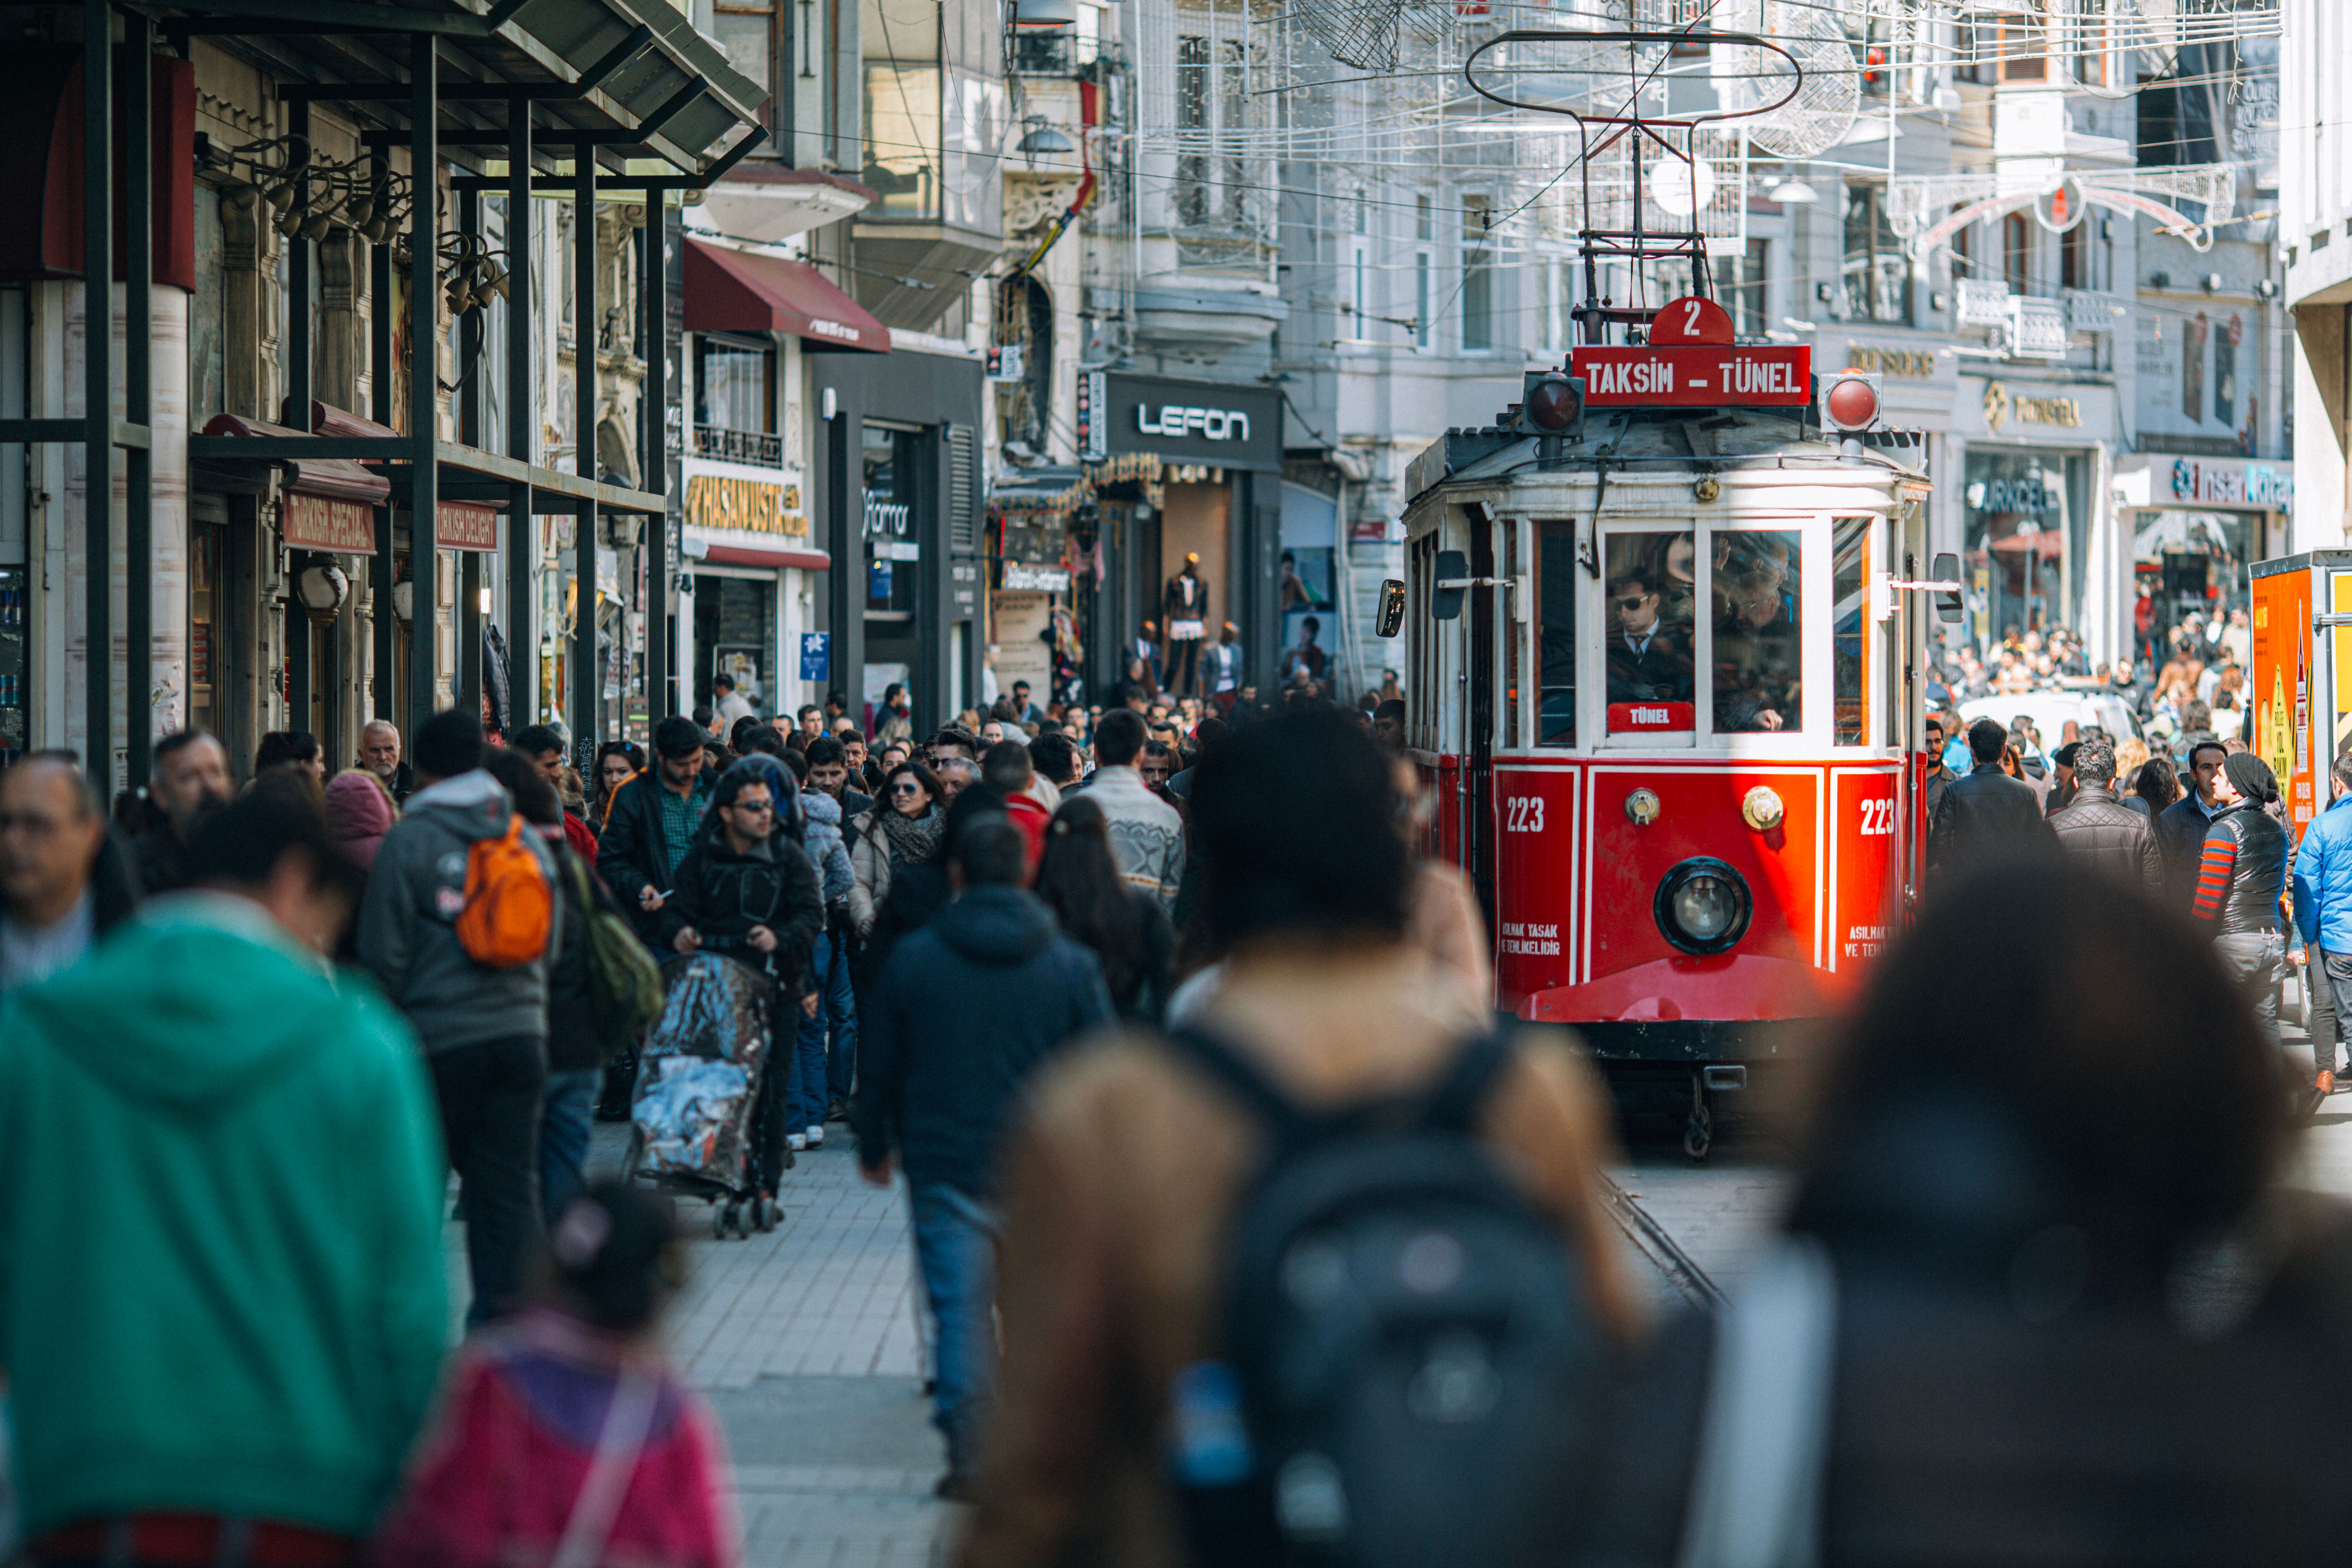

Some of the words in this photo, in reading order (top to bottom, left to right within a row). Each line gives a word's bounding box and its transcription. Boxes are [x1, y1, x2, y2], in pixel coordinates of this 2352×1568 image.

[1684, 301, 1701, 335] 2
[1586, 357, 1673, 393] TAKSİM
[1719, 357, 1802, 393] TÜNEL
[290, 494, 328, 542] TURKISH
[330, 501, 367, 548] SPECIAL
[437, 506, 464, 542] URKISH
[466, 510, 494, 544] DELIGHT
[1630, 706, 1670, 724] TÜNEL
[2274, 757, 2287, 778] BAKIM
[1508, 797, 1544, 832] 223
[1860, 799, 1894, 835] 223
[1528, 924, 1558, 938] YASAK
[1850, 926, 1885, 940] ASILMAK
[1507, 939, 1560, 956] TEHLİKELİDİR
[1844, 943, 1858, 957] VE
